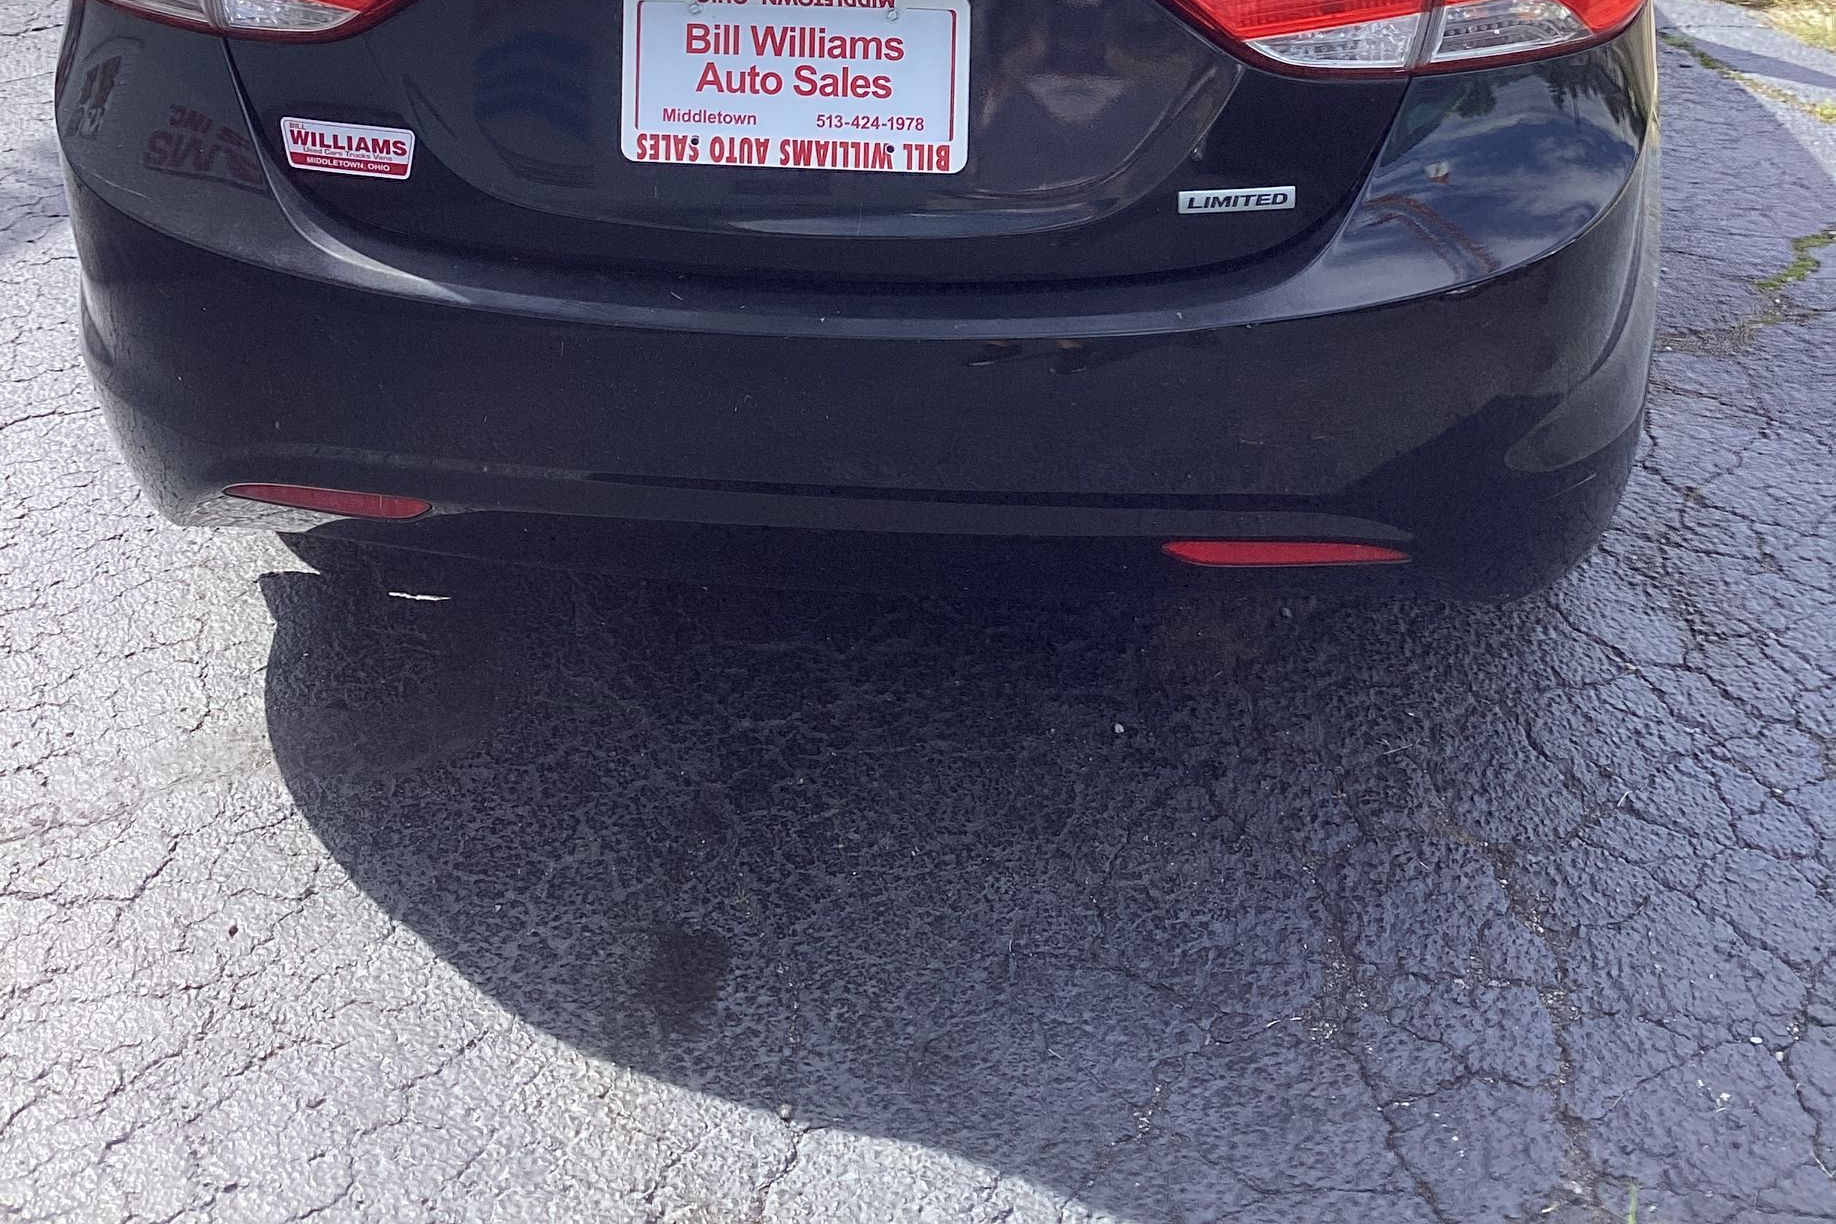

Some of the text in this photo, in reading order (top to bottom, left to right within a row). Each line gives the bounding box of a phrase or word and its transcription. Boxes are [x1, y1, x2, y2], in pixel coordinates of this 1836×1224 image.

[685, 23, 905, 62] Bill Williams
[695, 61, 893, 99] Auto Sales
[289, 122, 306, 130] BILL
[662, 107, 925, 131] Middletown 513-424-1978
[290, 129, 408, 157] WILLIAMS
[303, 146, 393, 162] Used Cars Trucks Vans
[636, 132, 951, 172] BILL WILLIAMS AUTO SALES
[367, 163, 391, 172] OHIO
[1187, 193, 1289, 210] LIMITED
